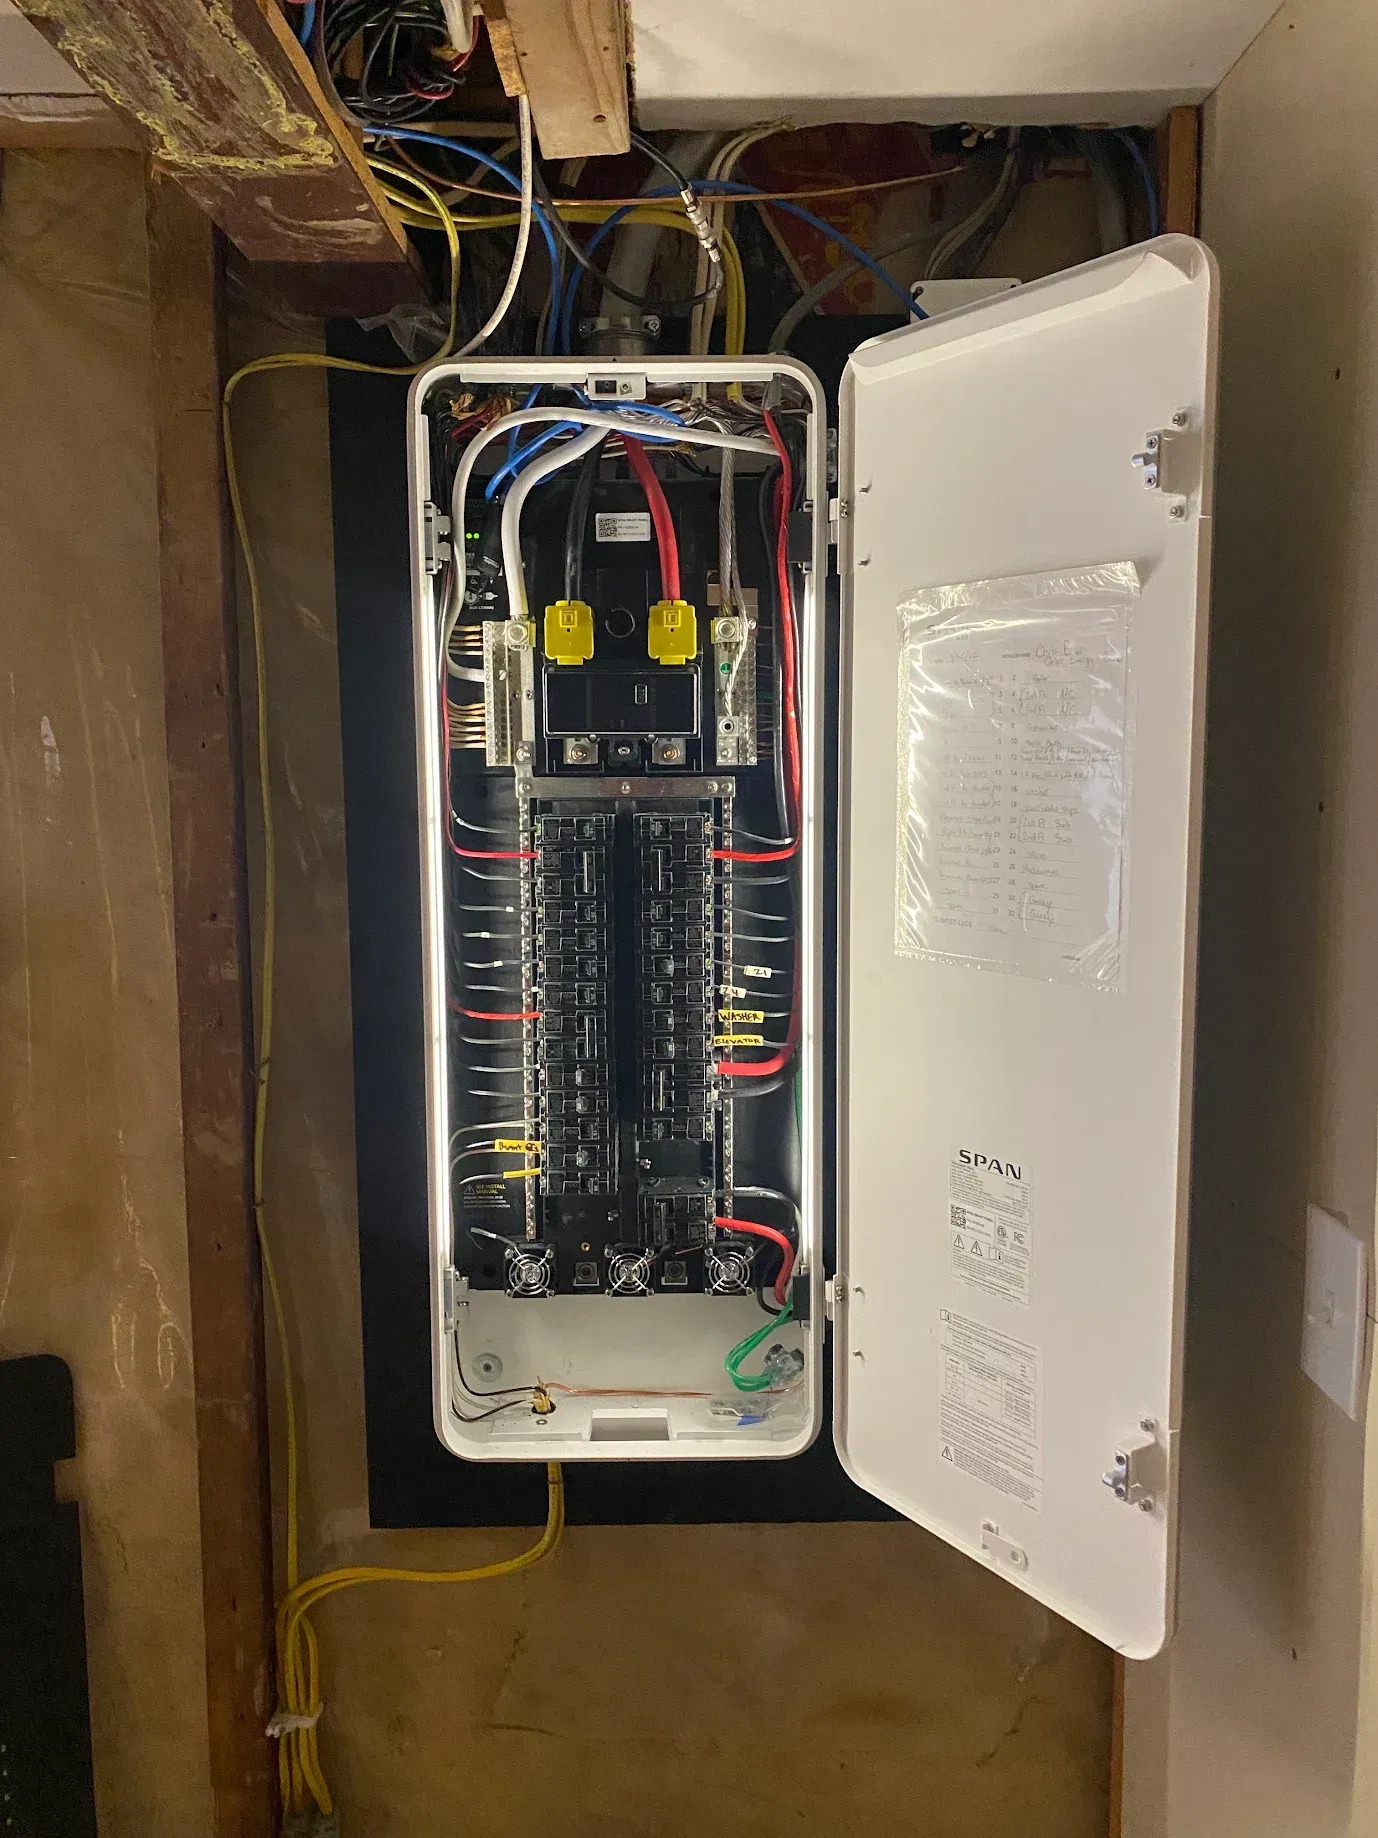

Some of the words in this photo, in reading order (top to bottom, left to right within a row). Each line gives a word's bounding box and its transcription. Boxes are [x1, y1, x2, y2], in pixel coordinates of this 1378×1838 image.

[1055, 818, 1071, 829] Sub
[1054, 832, 1073, 844] Sub
[958, 920, 973, 928] LUGS
[753, 968, 768, 977] 21
[719, 1012, 761, 1022] WASHER
[959, 1149, 1021, 1180] SPAN
